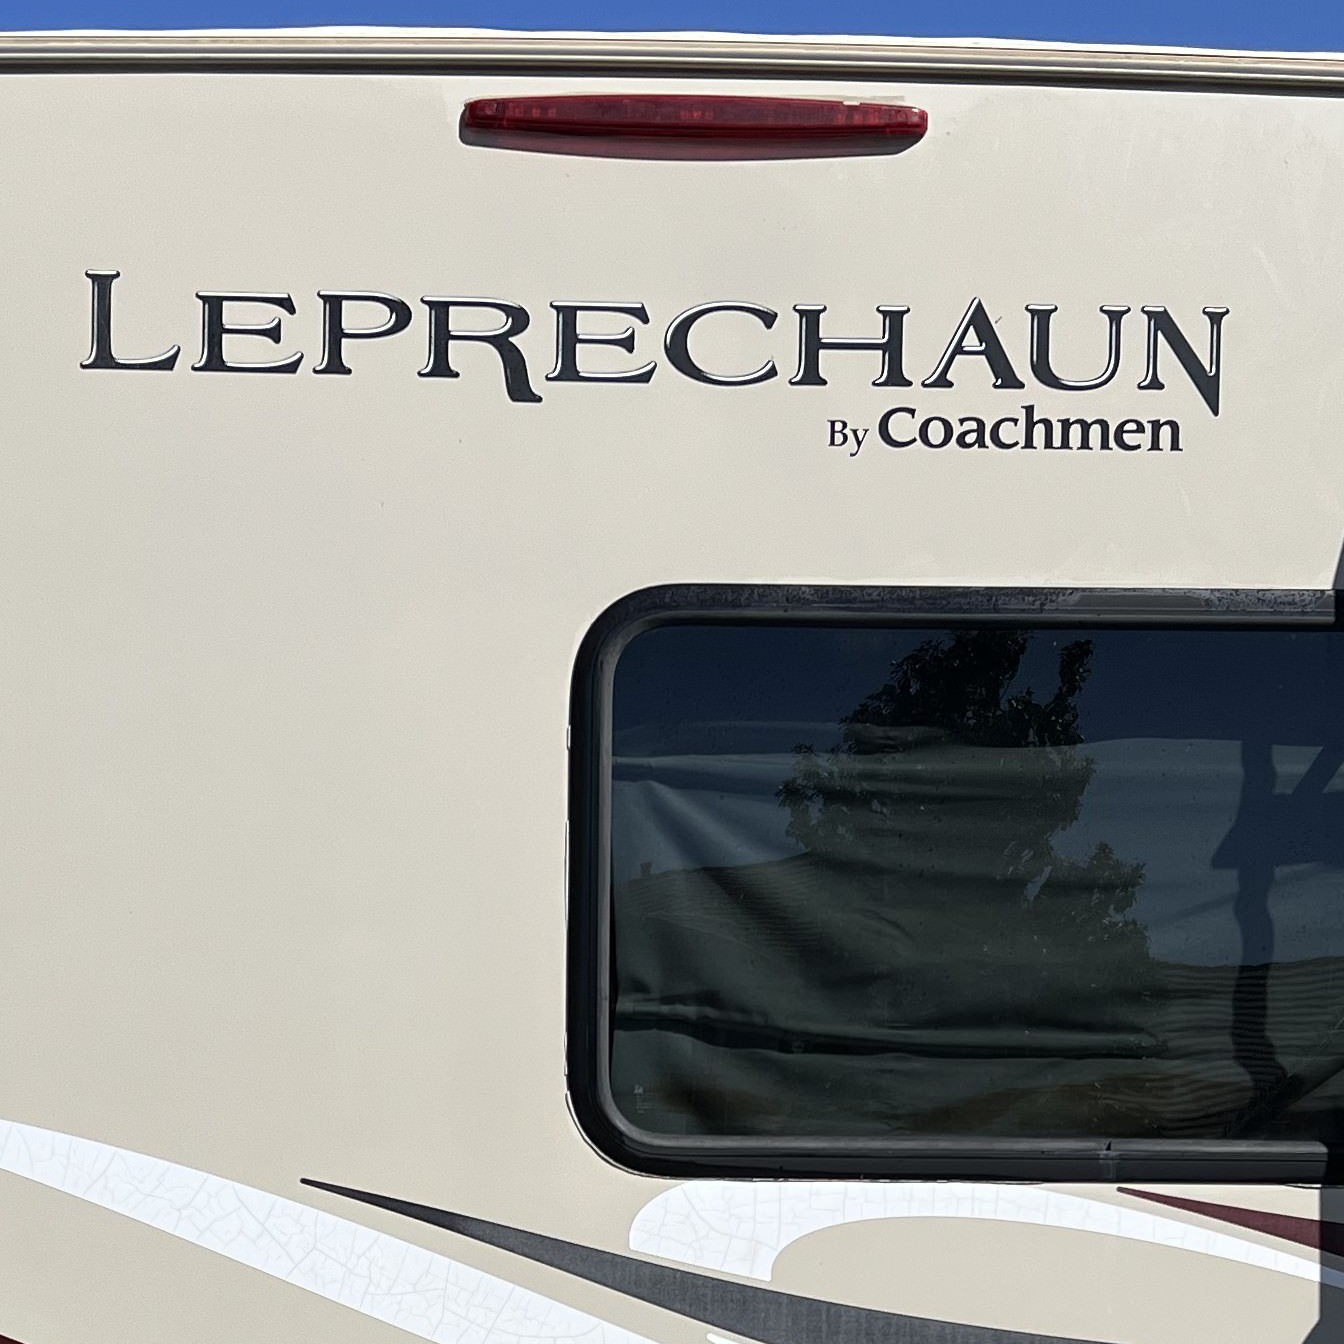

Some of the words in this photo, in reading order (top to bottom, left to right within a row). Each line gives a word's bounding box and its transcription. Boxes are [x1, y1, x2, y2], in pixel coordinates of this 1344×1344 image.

[79, 268, 1229, 418] LEPRECHAUN
[826, 418, 870, 457] By
[877, 404, 1184, 452] Coachmen
